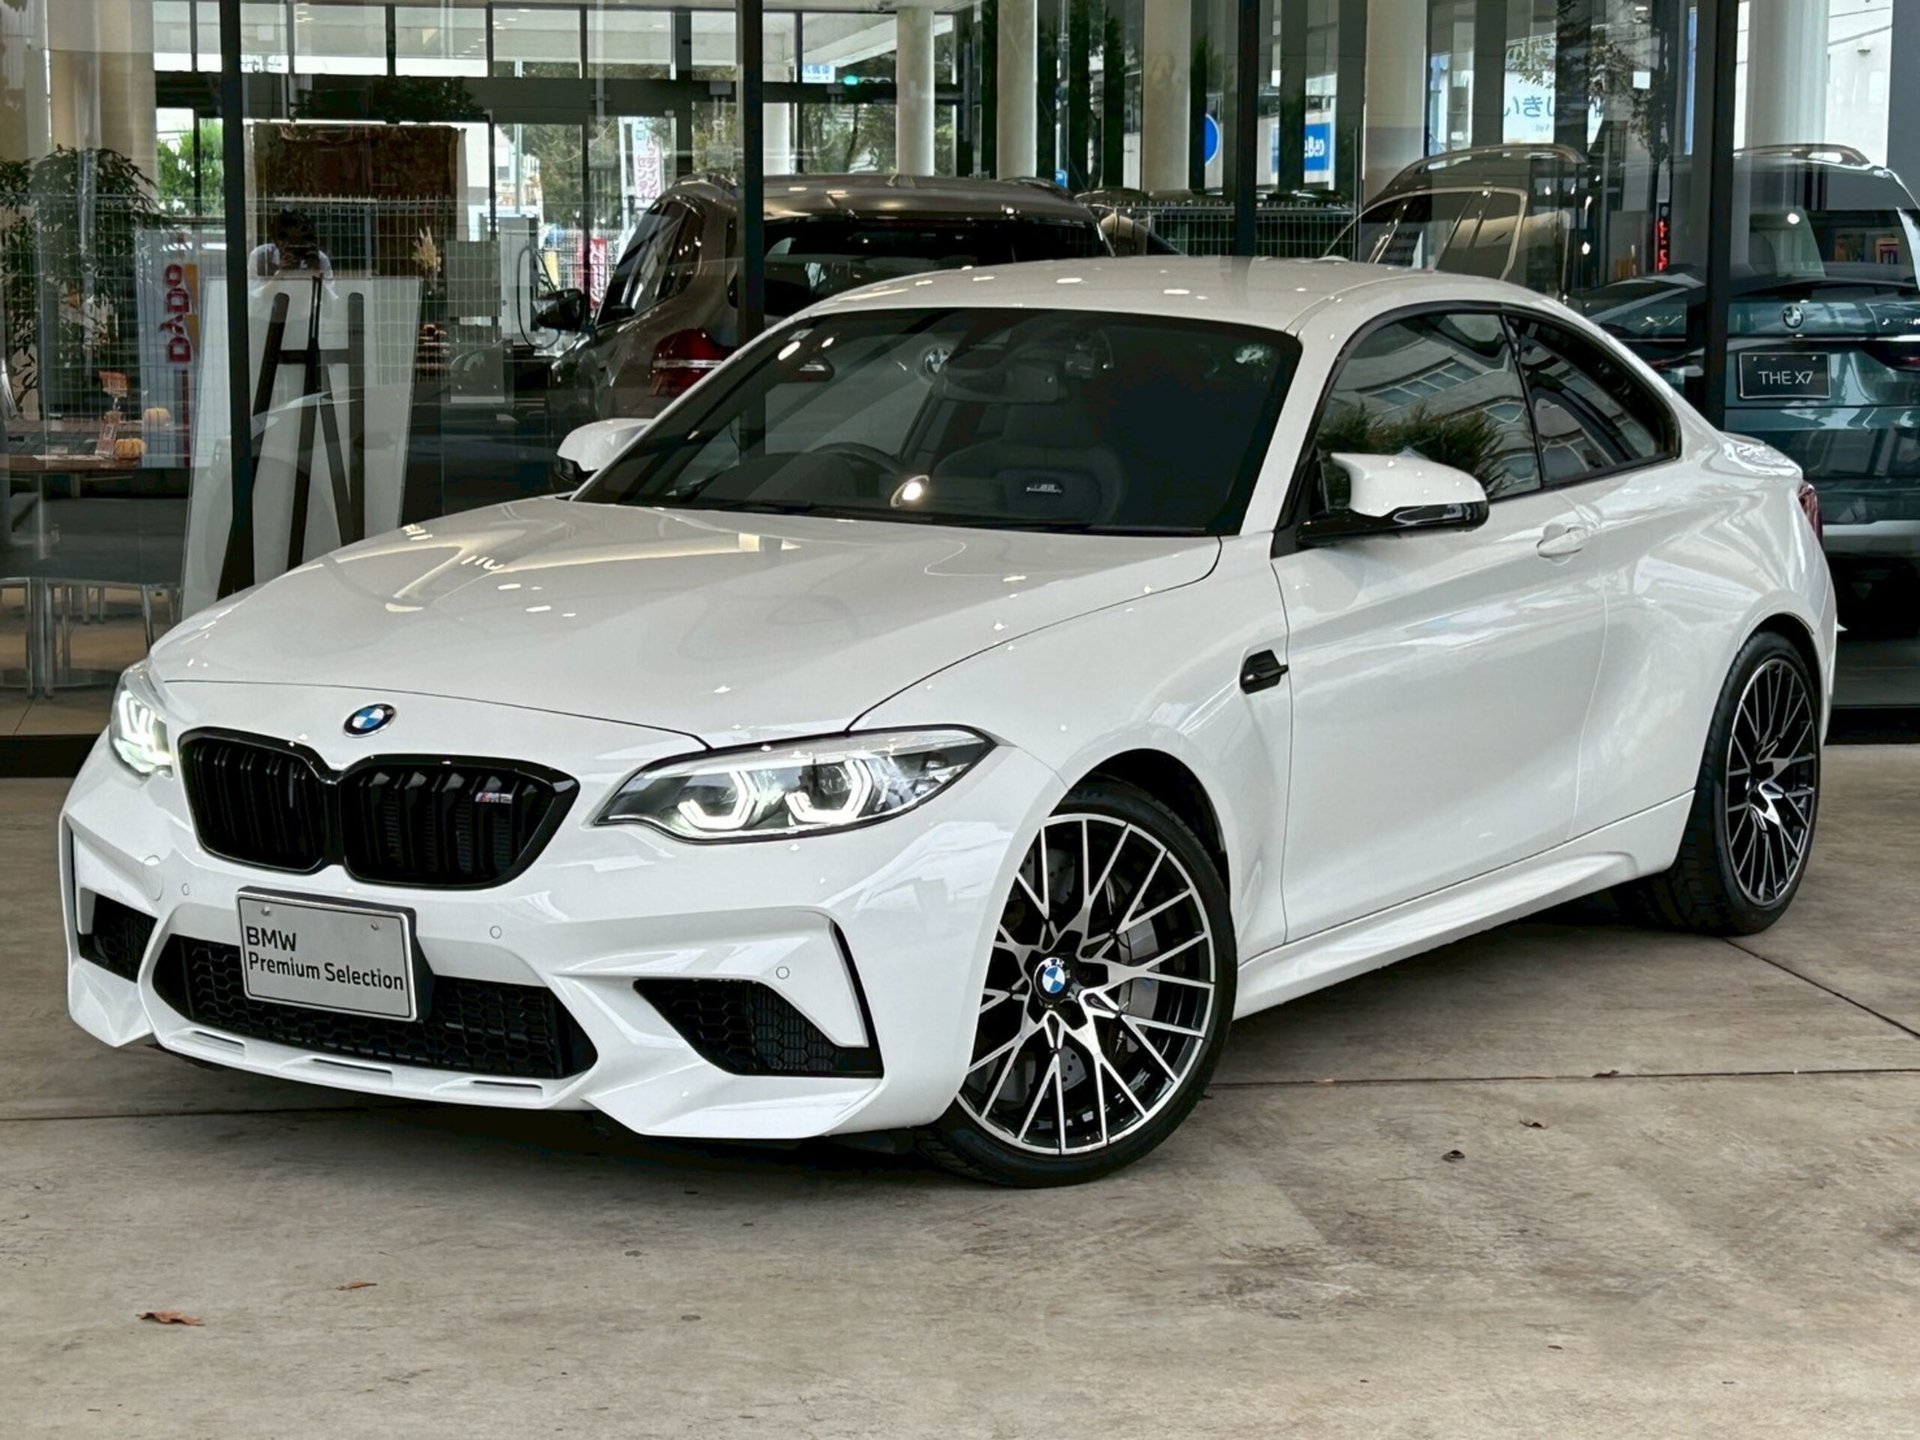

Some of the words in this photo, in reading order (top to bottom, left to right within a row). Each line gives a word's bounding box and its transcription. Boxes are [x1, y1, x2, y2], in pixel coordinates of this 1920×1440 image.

[1757, 370, 1792, 385] THE
[1795, 370, 1814, 385] X7
[246, 926, 297, 952] BMW
[248, 952, 321, 980] Premium
[324, 962, 404, 991] Selection
